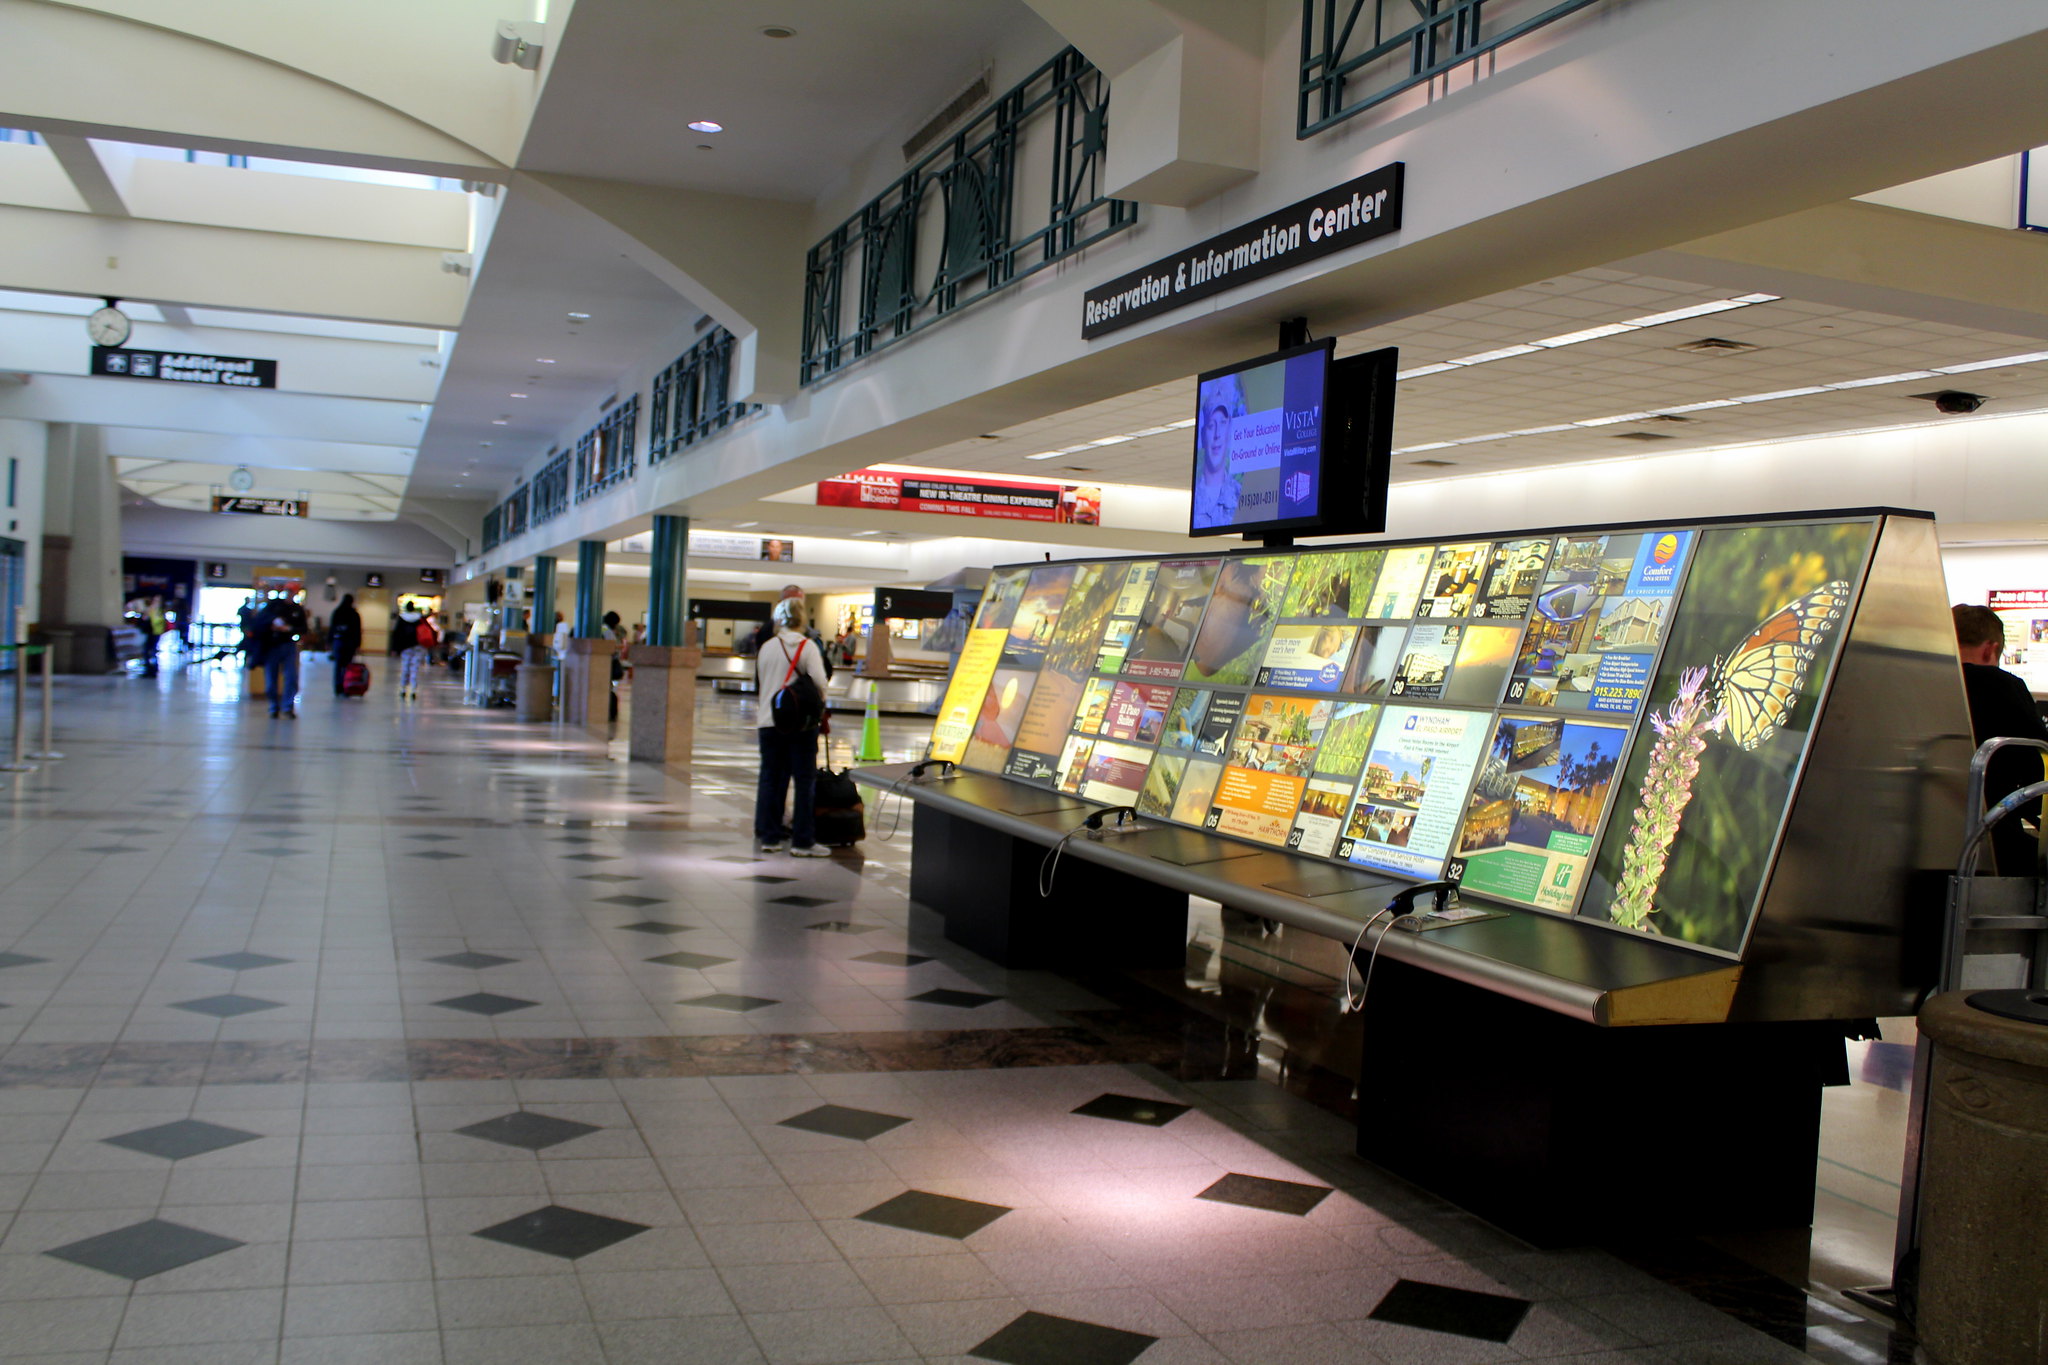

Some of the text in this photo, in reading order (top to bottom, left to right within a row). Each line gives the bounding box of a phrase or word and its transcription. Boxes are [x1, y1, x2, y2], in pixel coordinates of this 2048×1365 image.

[1085, 188, 1388, 327] Reservation & Information Center
[160, 354, 254, 374] Additional
[160, 366, 261, 386] Rental Cars
[1285, 411, 1315, 430] VISTA
[1233, 423, 1280, 440] Get Your Education
[1296, 428, 1318, 440] COLLEGE
[1231, 447, 1257, 461] On-Ground
[1264, 442, 1280, 456] Online
[903, 480, 919, 488] COME
[870, 486, 899, 497] movie
[919, 488, 1054, 508] NEW IN-THEATRE DINING EXPERIENCE
[870, 495, 899, 504] bistro
[919, 502, 945, 512] COMING
[946, 504, 960, 513] THIS
[960, 505, 977, 514] FALL
[1643, 565, 1673, 576] Comfort
[883, 596, 893, 610] 3
[1419, 603, 1432, 617] 37
[1473, 603, 1486, 617] 38
[1275, 638, 1288, 646] catch
[1259, 671, 1269, 684] 18
[1392, 681, 1405, 695] 39
[1510, 681, 1524, 698] 06
[1119, 703, 1140, 716] El Paso
[1116, 715, 1135, 727] Suites
[1419, 715, 1451, 725] WYNDHAM
[1439, 727, 1462, 735] AIRPORT
[1207, 816, 1217, 827] 05
[1258, 825, 1287, 838] HAWTHORN
[1290, 832, 1301, 845] 23
[1339, 842, 1353, 858] 28
[1367, 845, 1387, 855] Complete
[1397, 851, 1413, 860] Service
[1413, 854, 1425, 864] Hotel
[1448, 863, 1463, 880] 32
[1541, 886, 1573, 901] Holiday Inn
